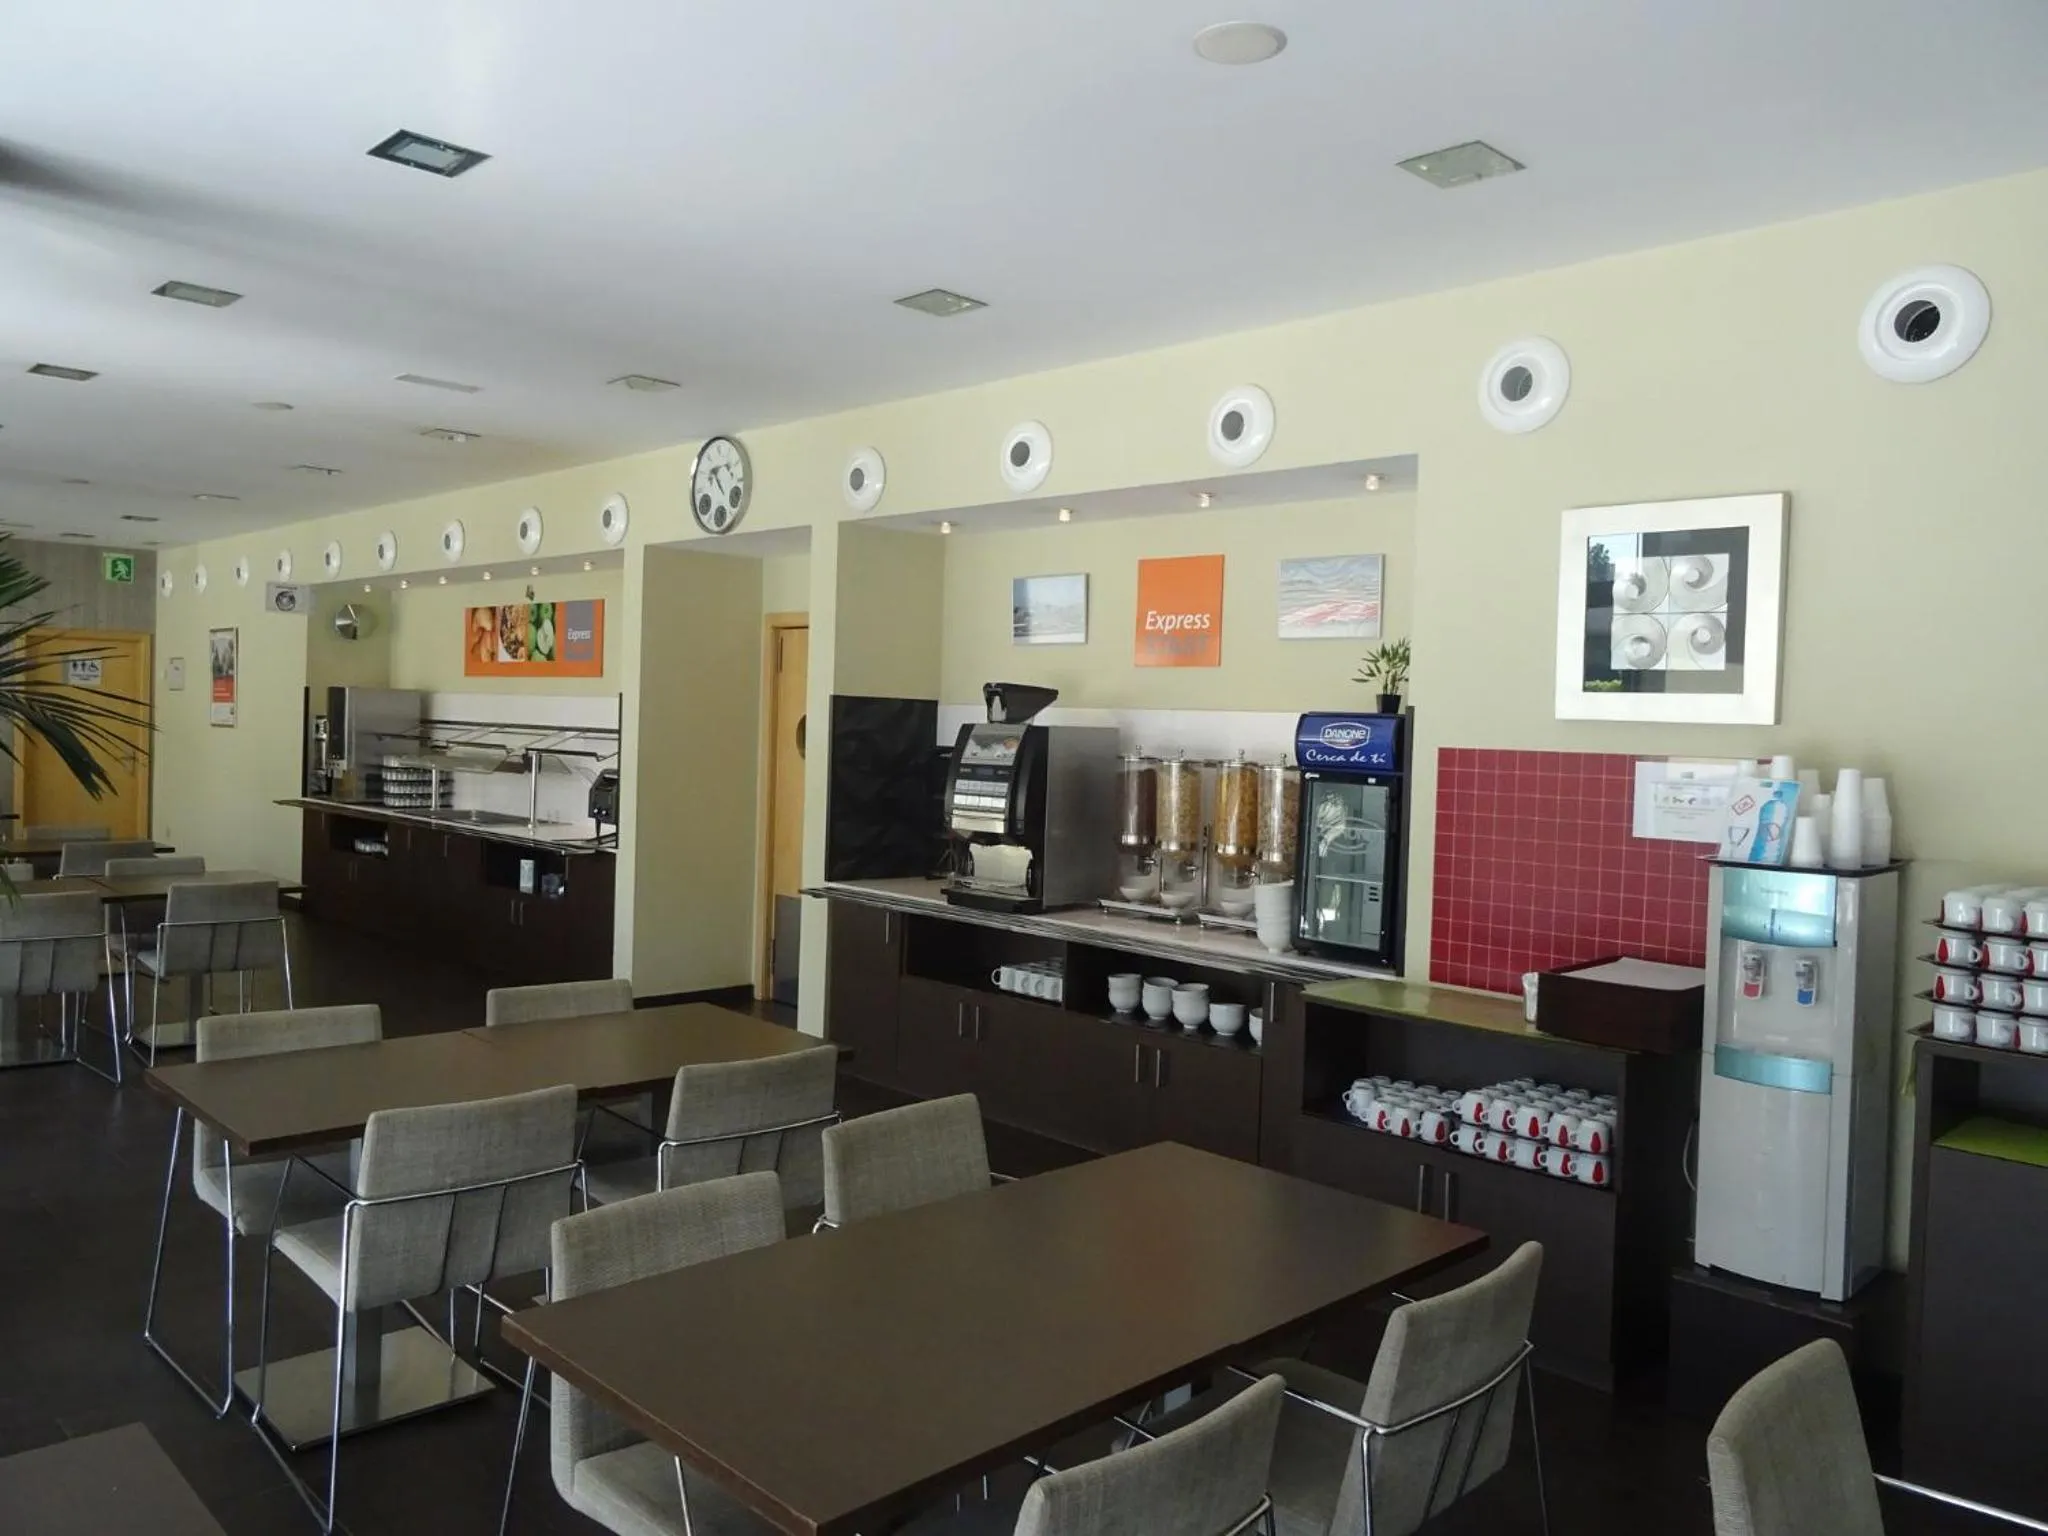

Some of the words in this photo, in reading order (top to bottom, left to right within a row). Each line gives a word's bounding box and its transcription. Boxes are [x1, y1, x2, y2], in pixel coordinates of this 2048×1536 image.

[1145, 610, 1211, 634] Express
[1324, 728, 1366, 739] DANONE
[1305, 749, 1346, 761] Cerca
[1350, 751, 1368, 762] de
